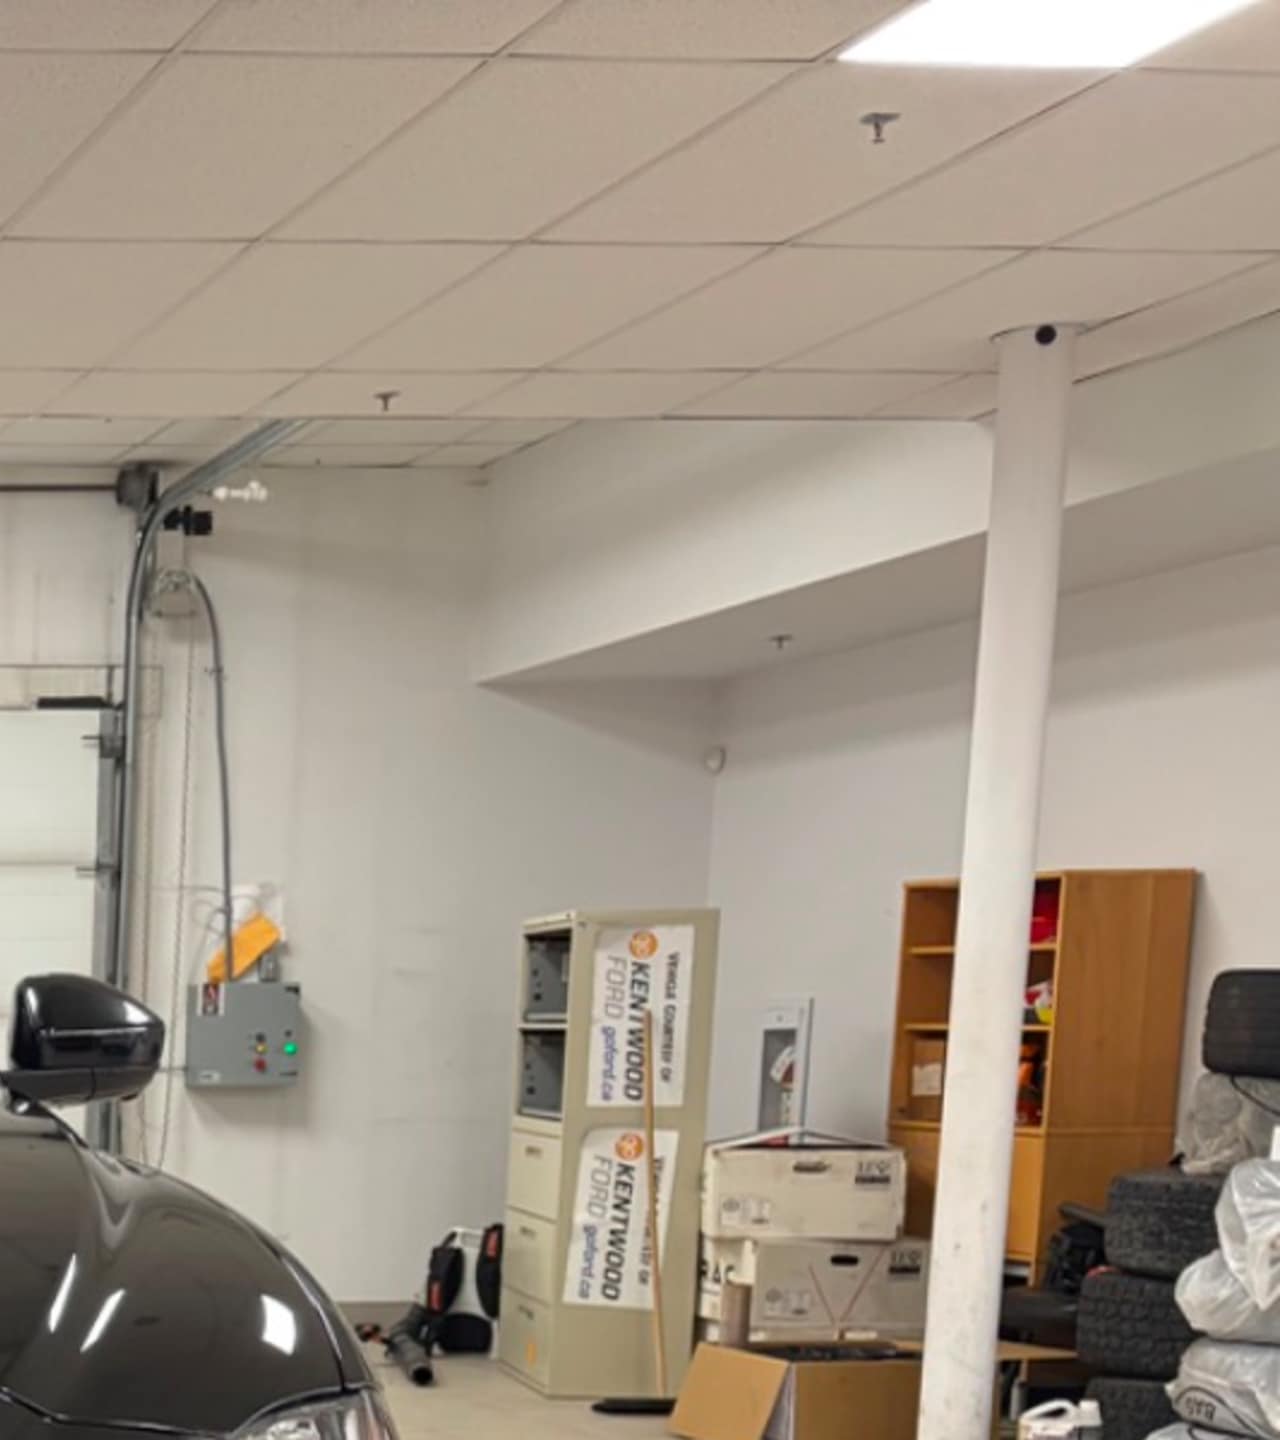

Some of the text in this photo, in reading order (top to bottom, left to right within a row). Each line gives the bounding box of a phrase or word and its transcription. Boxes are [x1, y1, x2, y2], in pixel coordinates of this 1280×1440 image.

[605, 955, 627, 1020] FORD
[623, 961, 650, 1101] KENTWOOD
[587, 1155, 613, 1220] FORD
[600, 1162, 636, 1302] KENTWOOD
